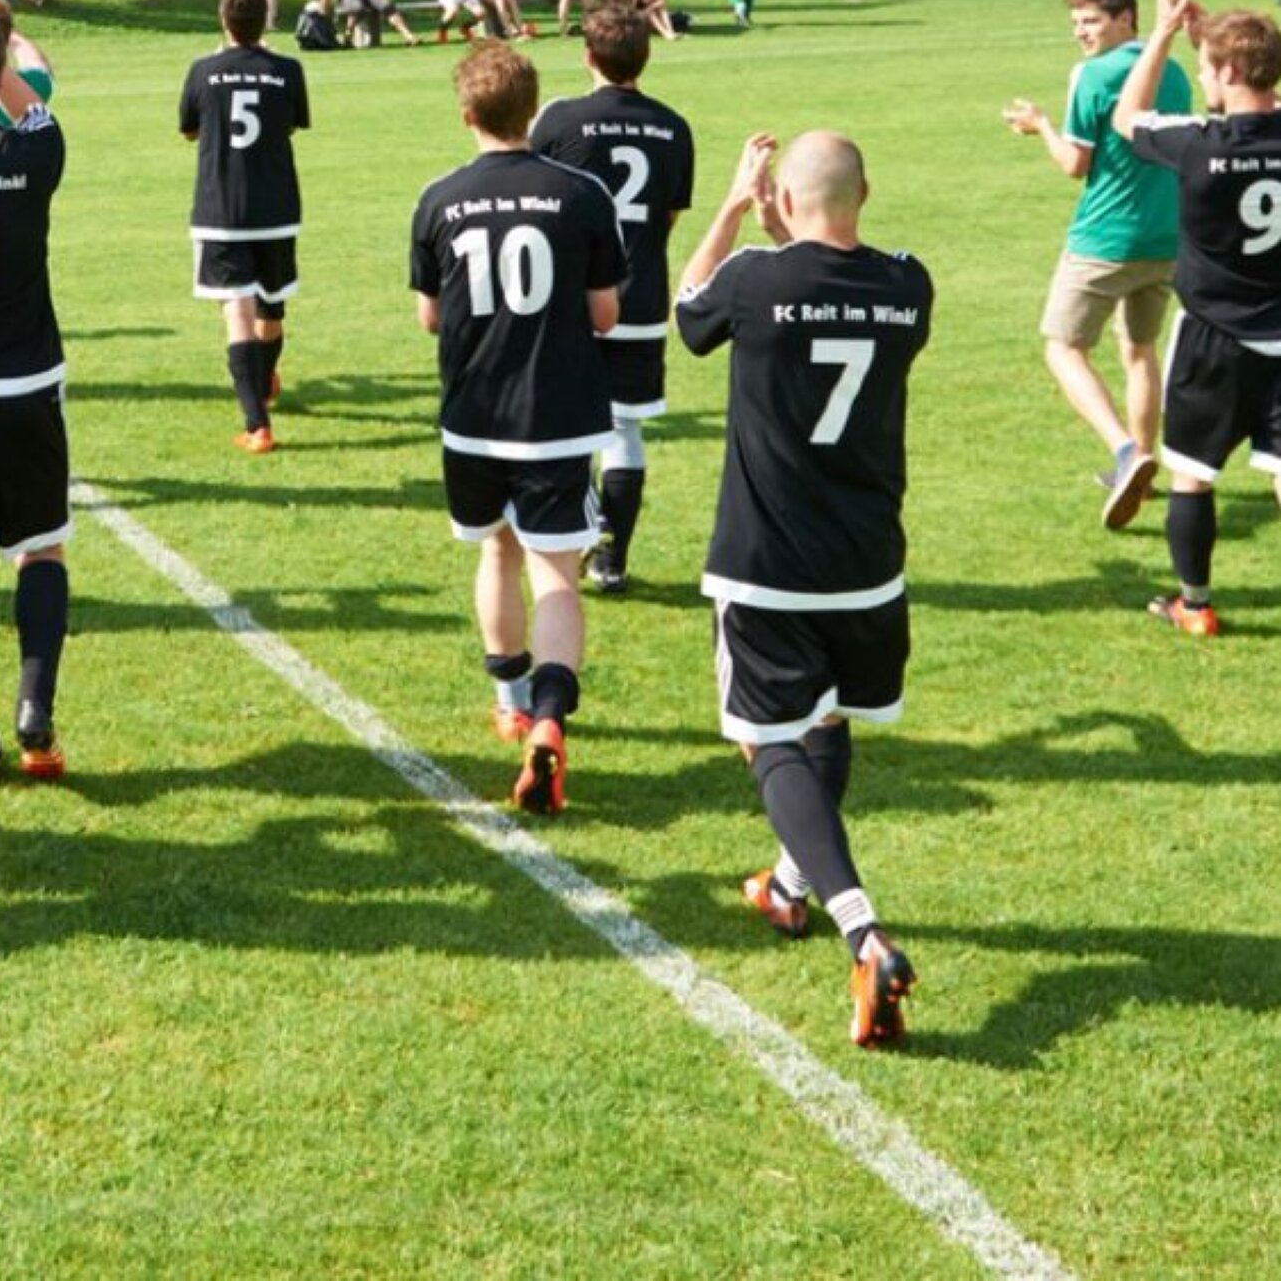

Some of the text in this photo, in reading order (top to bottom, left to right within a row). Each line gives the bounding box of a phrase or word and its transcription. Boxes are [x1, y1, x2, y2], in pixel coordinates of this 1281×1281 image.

[230, 90, 261, 149] 5
[611, 145, 649, 222] 2
[1239, 179, 1281, 255] 9
[451, 224, 554, 316] 10
[773, 303, 918, 326] FC Reit im Winkl
[810, 338, 876, 445] 7
